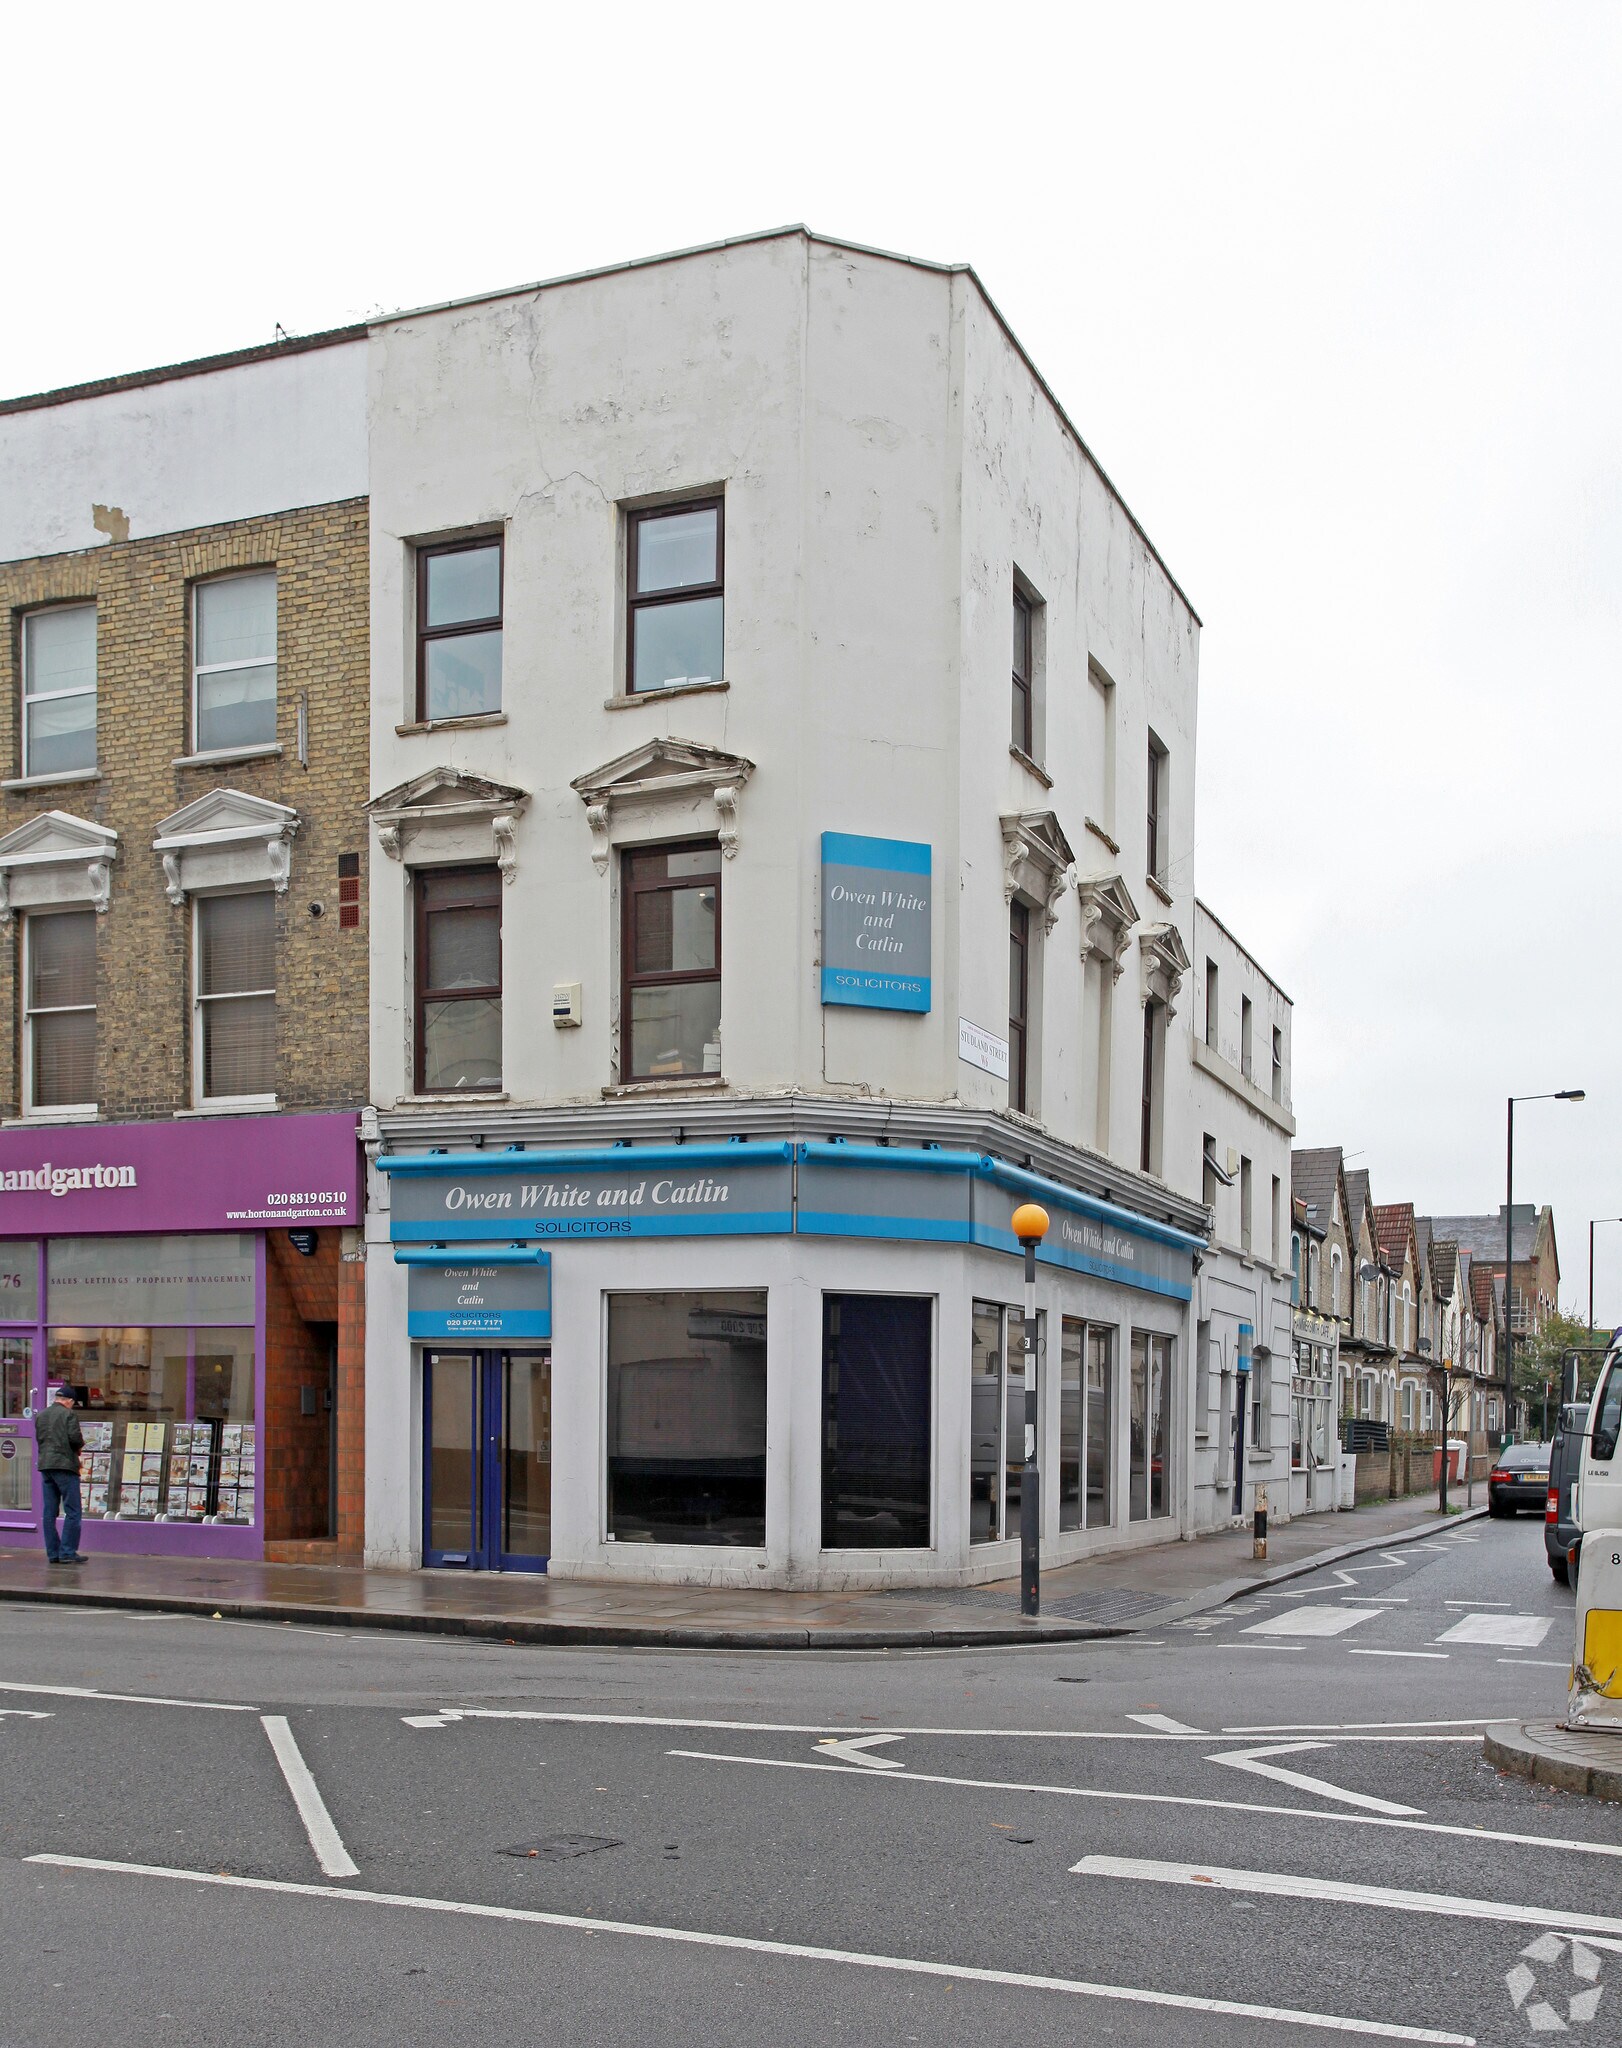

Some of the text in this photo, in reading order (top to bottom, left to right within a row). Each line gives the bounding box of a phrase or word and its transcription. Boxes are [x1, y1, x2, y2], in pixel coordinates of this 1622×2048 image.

[831, 885, 927, 911] Owen White
[863, 914, 895, 929] and
[856, 933, 904, 953] Catlin
[836, 975, 921, 993] SOLICITORS
[960, 1030, 988, 1053] STUDLAND
[989, 1044, 1007, 1063] STREET
[267, 1191, 347, 1205] 020 8819 0510
[445, 1179, 729, 1210] Owen White and Catlin
[226, 1207, 347, 1220] www.hortonandgarton.co.uk
[535, 1221, 632, 1234] SOLICITORS
[1062, 1219, 1134, 1260] Owen White and Catlin
[444, 1267, 498, 1278] Owen White
[1089, 1260, 1115, 1276] SOLICITORS
[136, 1276, 184, 1284] PROPERTY
[187, 1275, 252, 1283] MANAGEMENT
[462, 1281, 480, 1291] and
[457, 1295, 484, 1305] Catlin
[1611, 1553, 1621, 1565] 8
